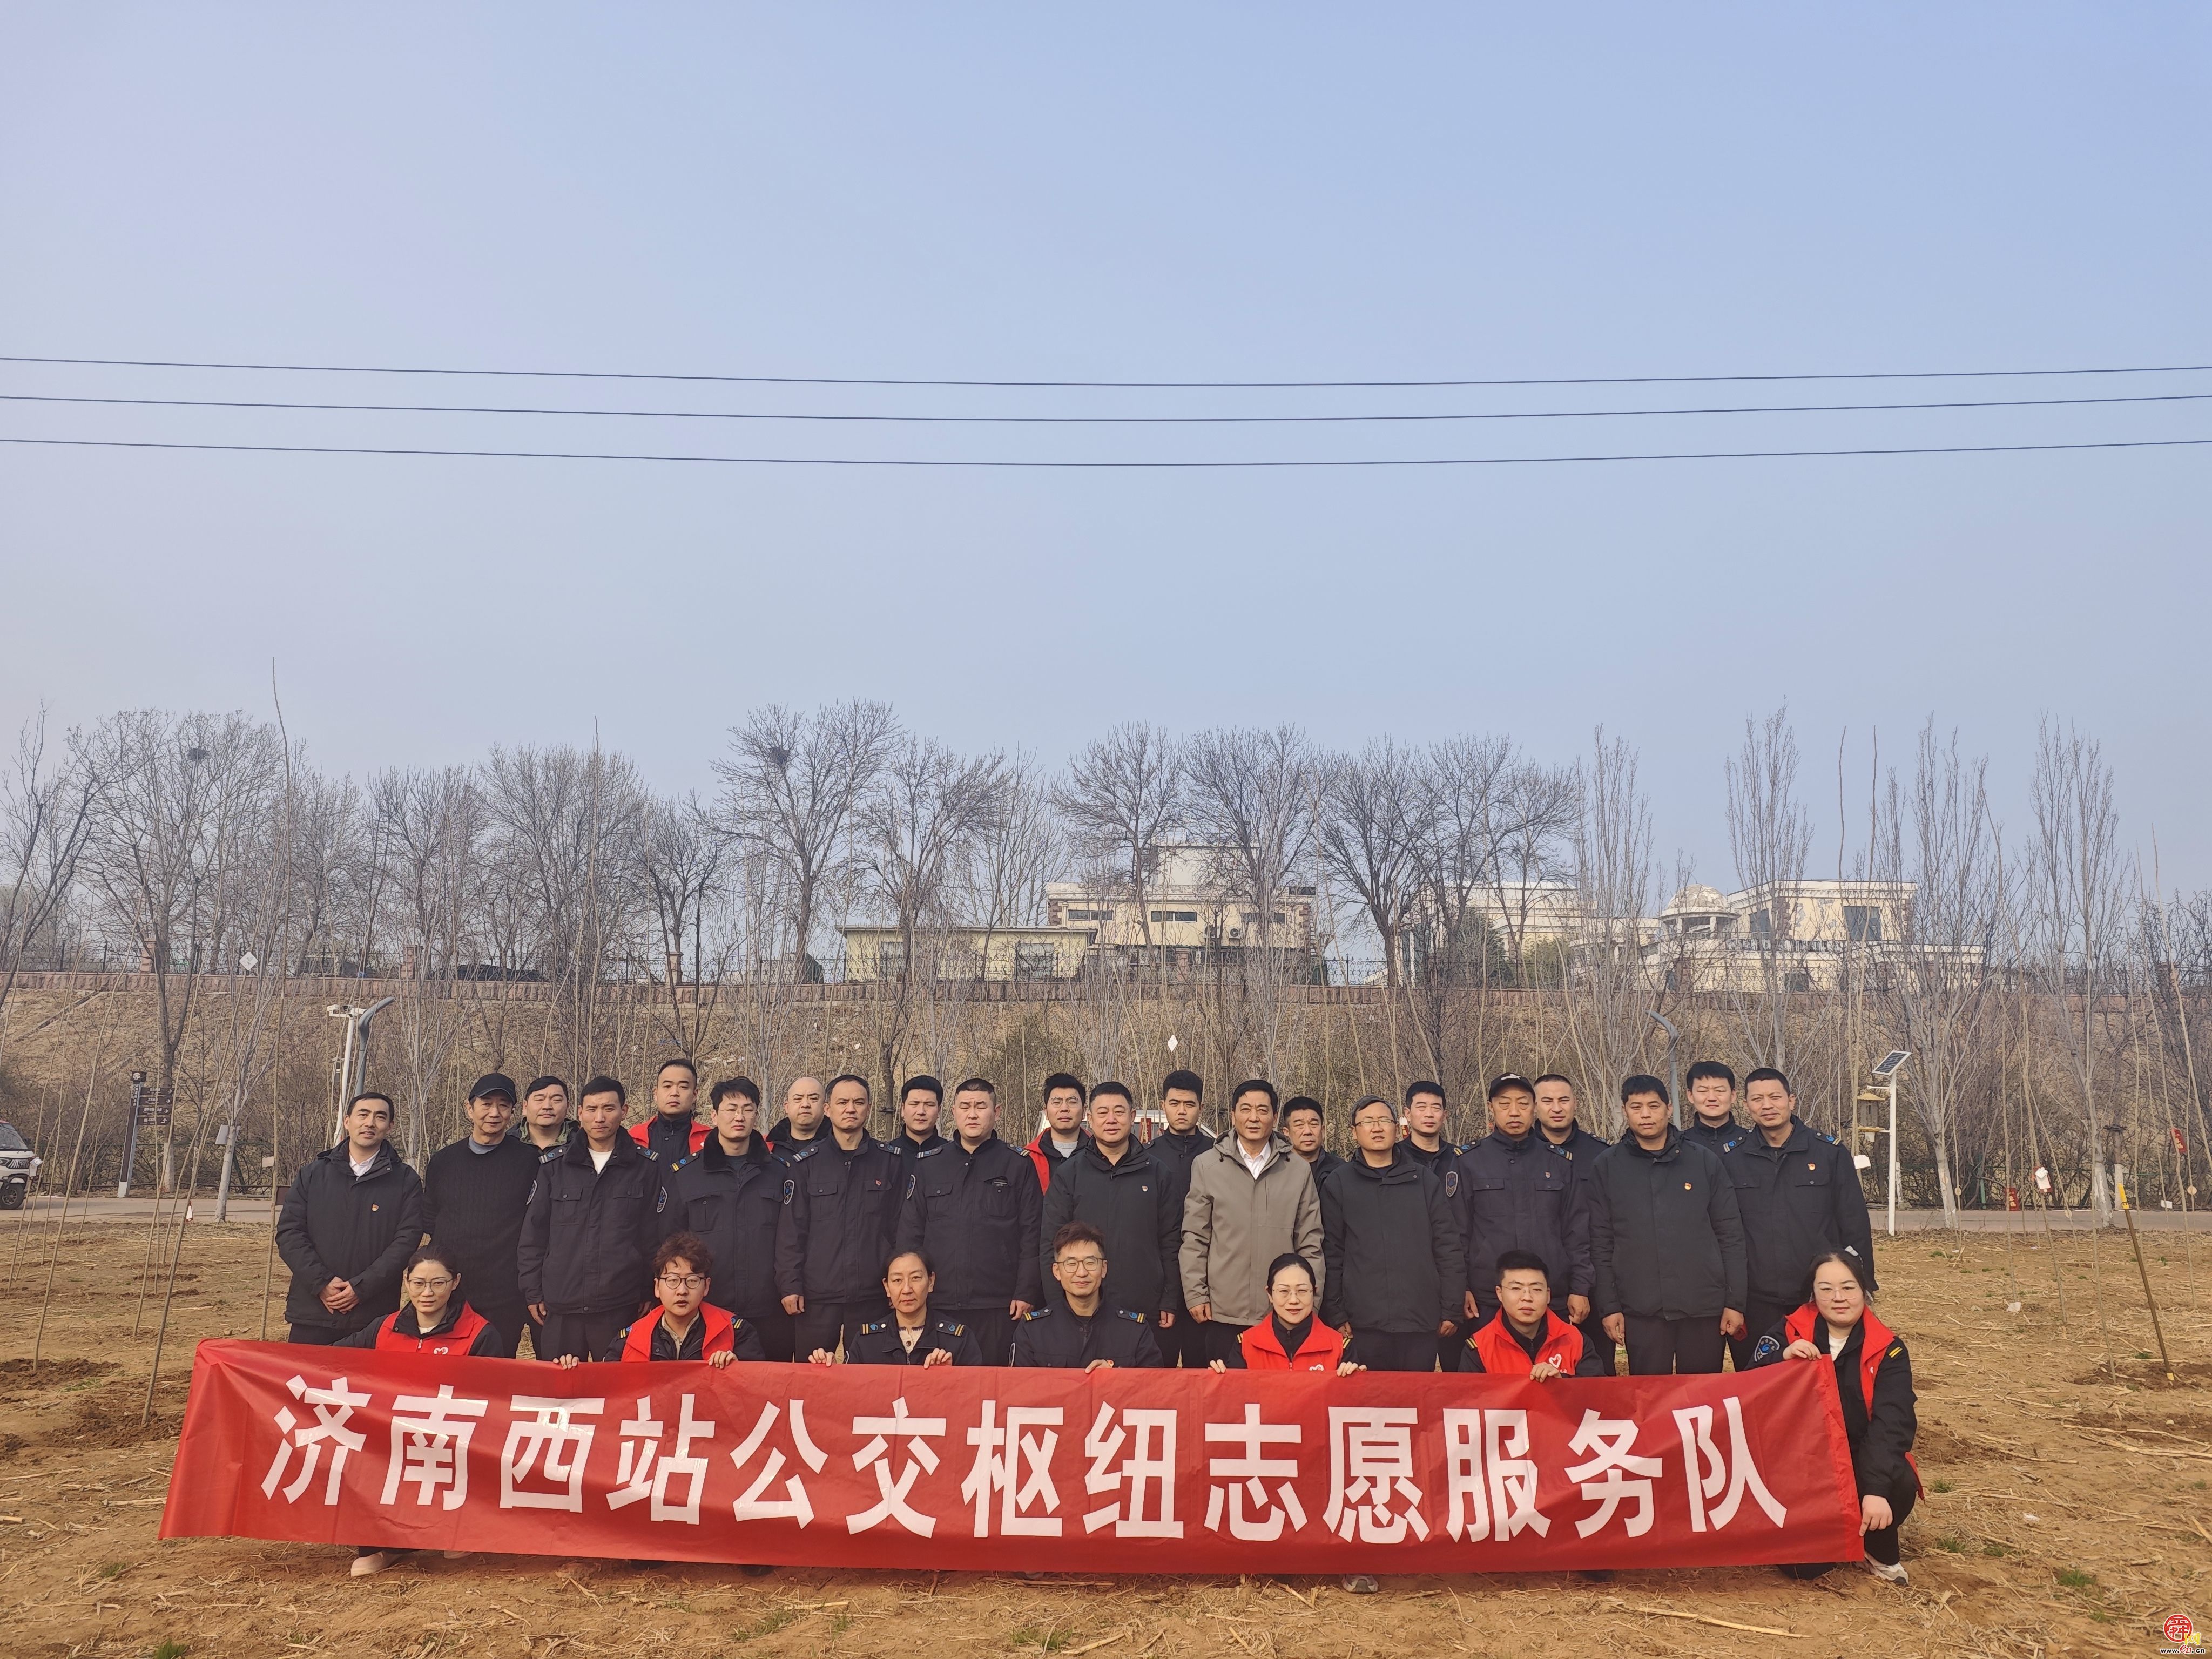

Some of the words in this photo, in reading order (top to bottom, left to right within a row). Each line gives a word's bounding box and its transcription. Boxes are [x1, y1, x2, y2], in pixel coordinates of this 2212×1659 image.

[261, 1374, 1788, 1545] 济南西站公交枢纽志愿服务队
